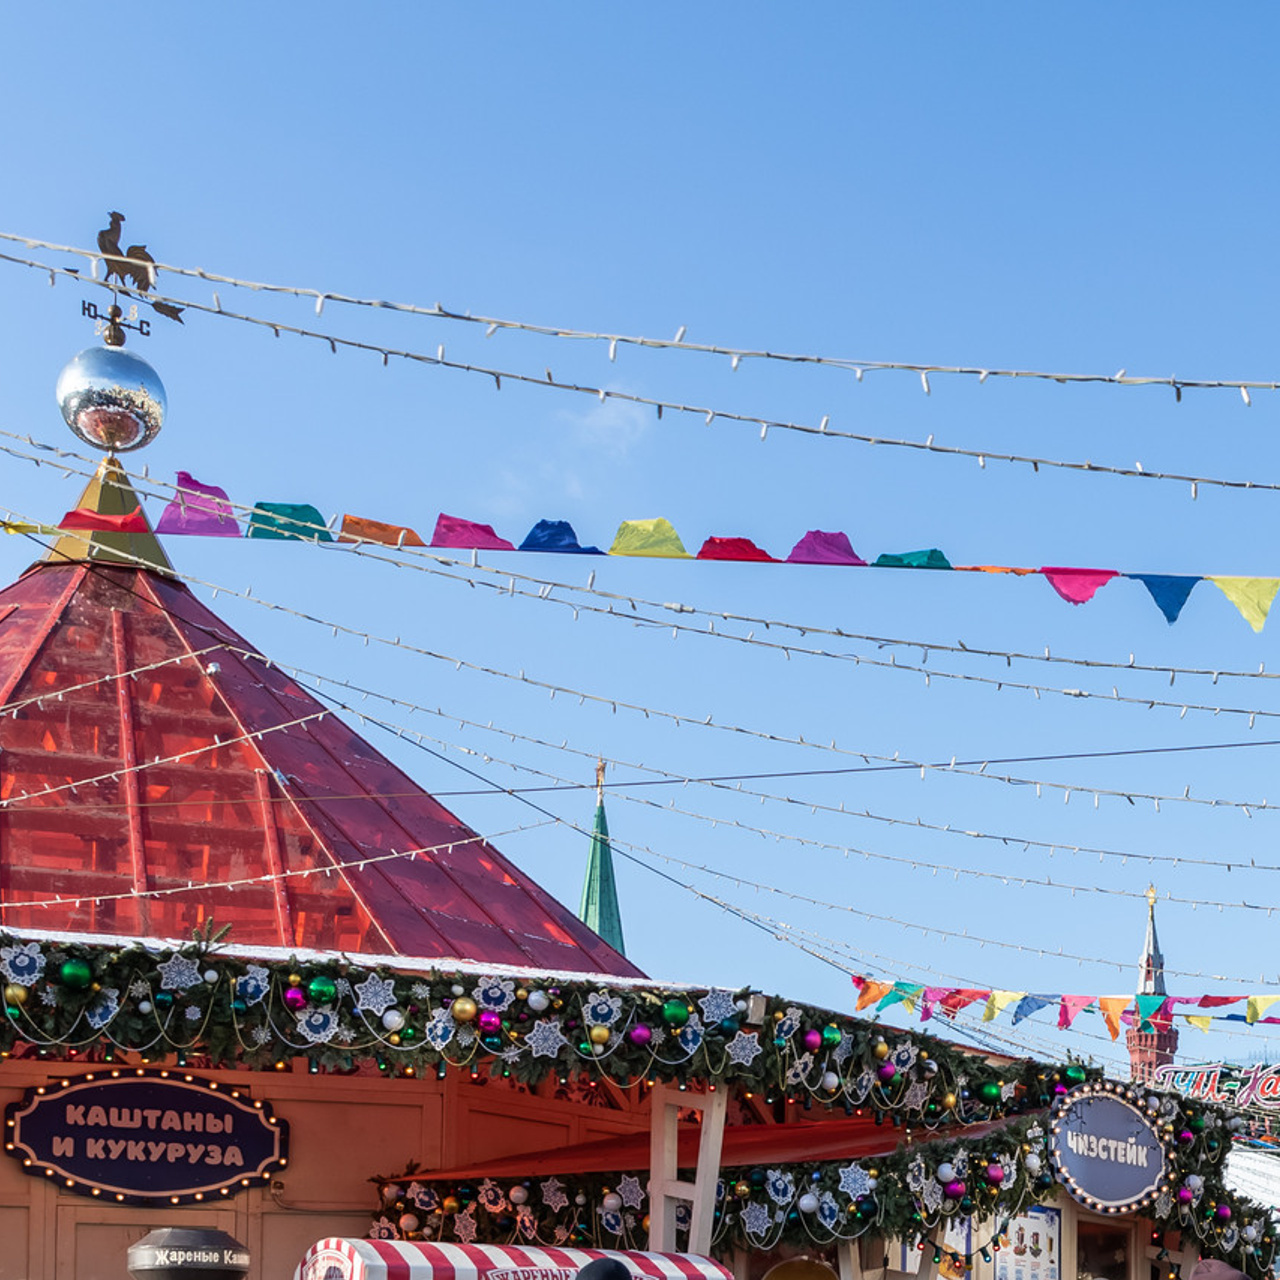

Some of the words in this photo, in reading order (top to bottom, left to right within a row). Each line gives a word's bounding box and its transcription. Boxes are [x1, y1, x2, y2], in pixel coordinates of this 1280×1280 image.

[82, 300, 97, 320] Ю
[140, 320, 151, 336] С
[66, 1104, 233, 1134] КАШТАНЫ
[52, 1136, 74, 1158] И
[86, 1138, 244, 1166] КУКУРУЗА
[1067, 1130, 1147, 1168] ЧИЗСТЕЙК
[155, 1249, 220, 1266] Жареные
